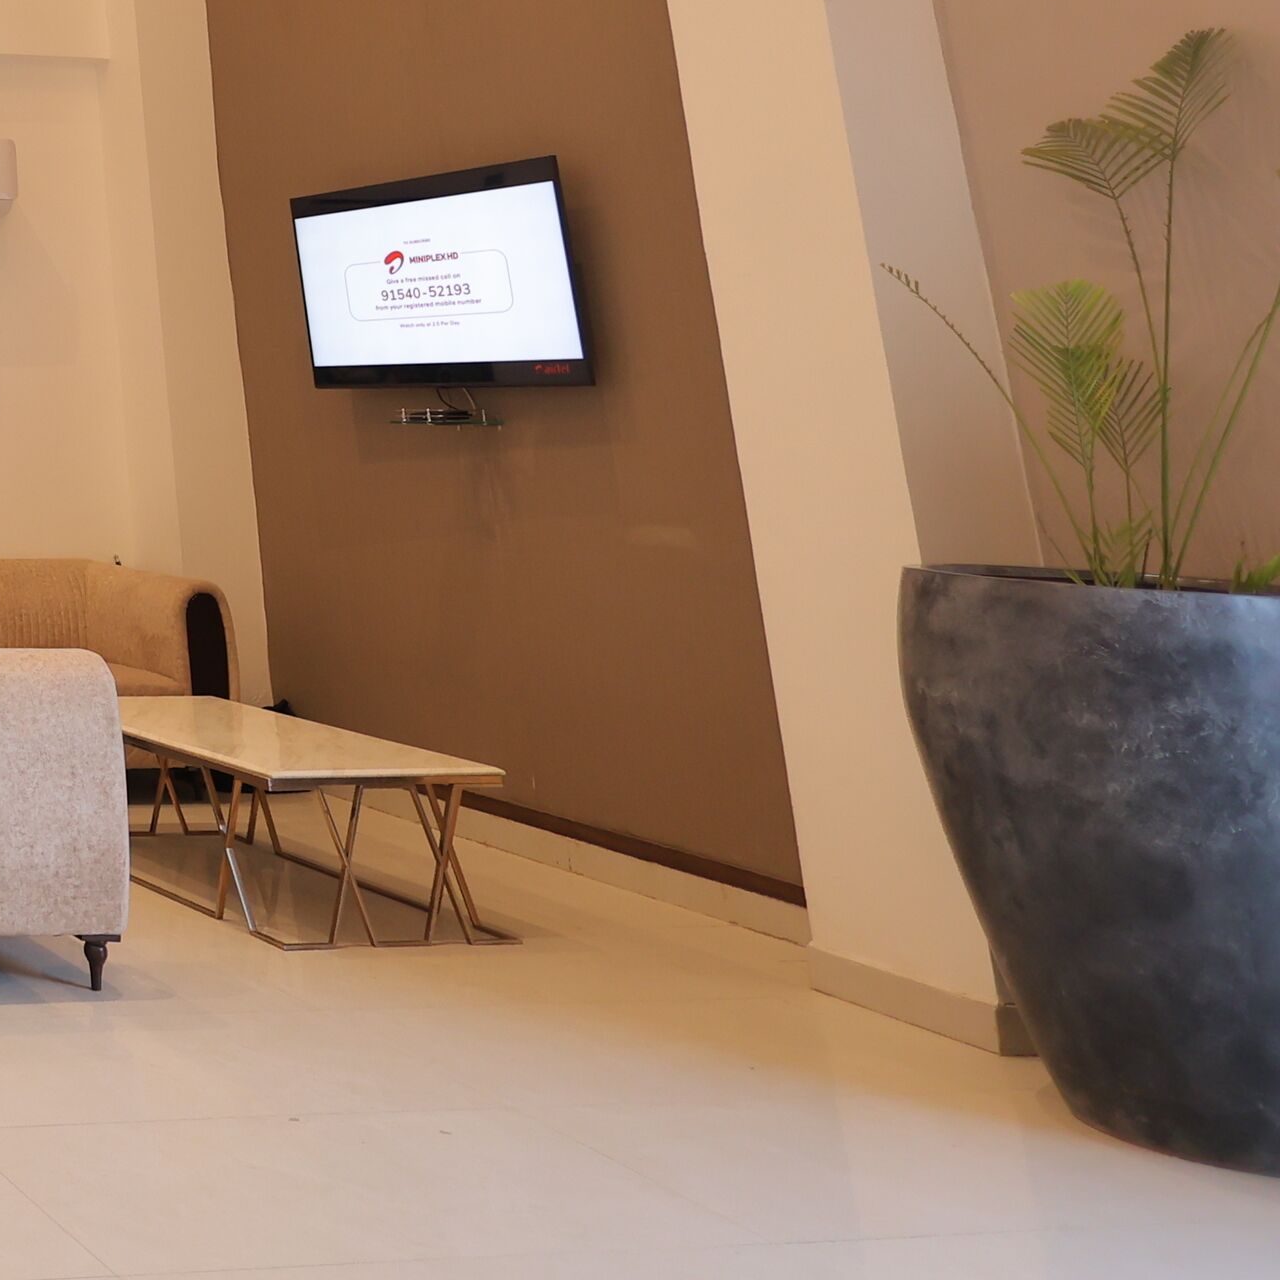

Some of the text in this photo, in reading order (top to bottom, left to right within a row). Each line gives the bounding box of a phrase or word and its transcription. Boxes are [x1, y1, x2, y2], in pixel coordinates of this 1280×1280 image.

[409, 251, 459, 264] MINIPLEX HD
[418, 274, 439, 282] missed
[381, 283, 471, 301] 91540-52193
[404, 301, 434, 310] registered
[435, 299, 456, 307] mobile
